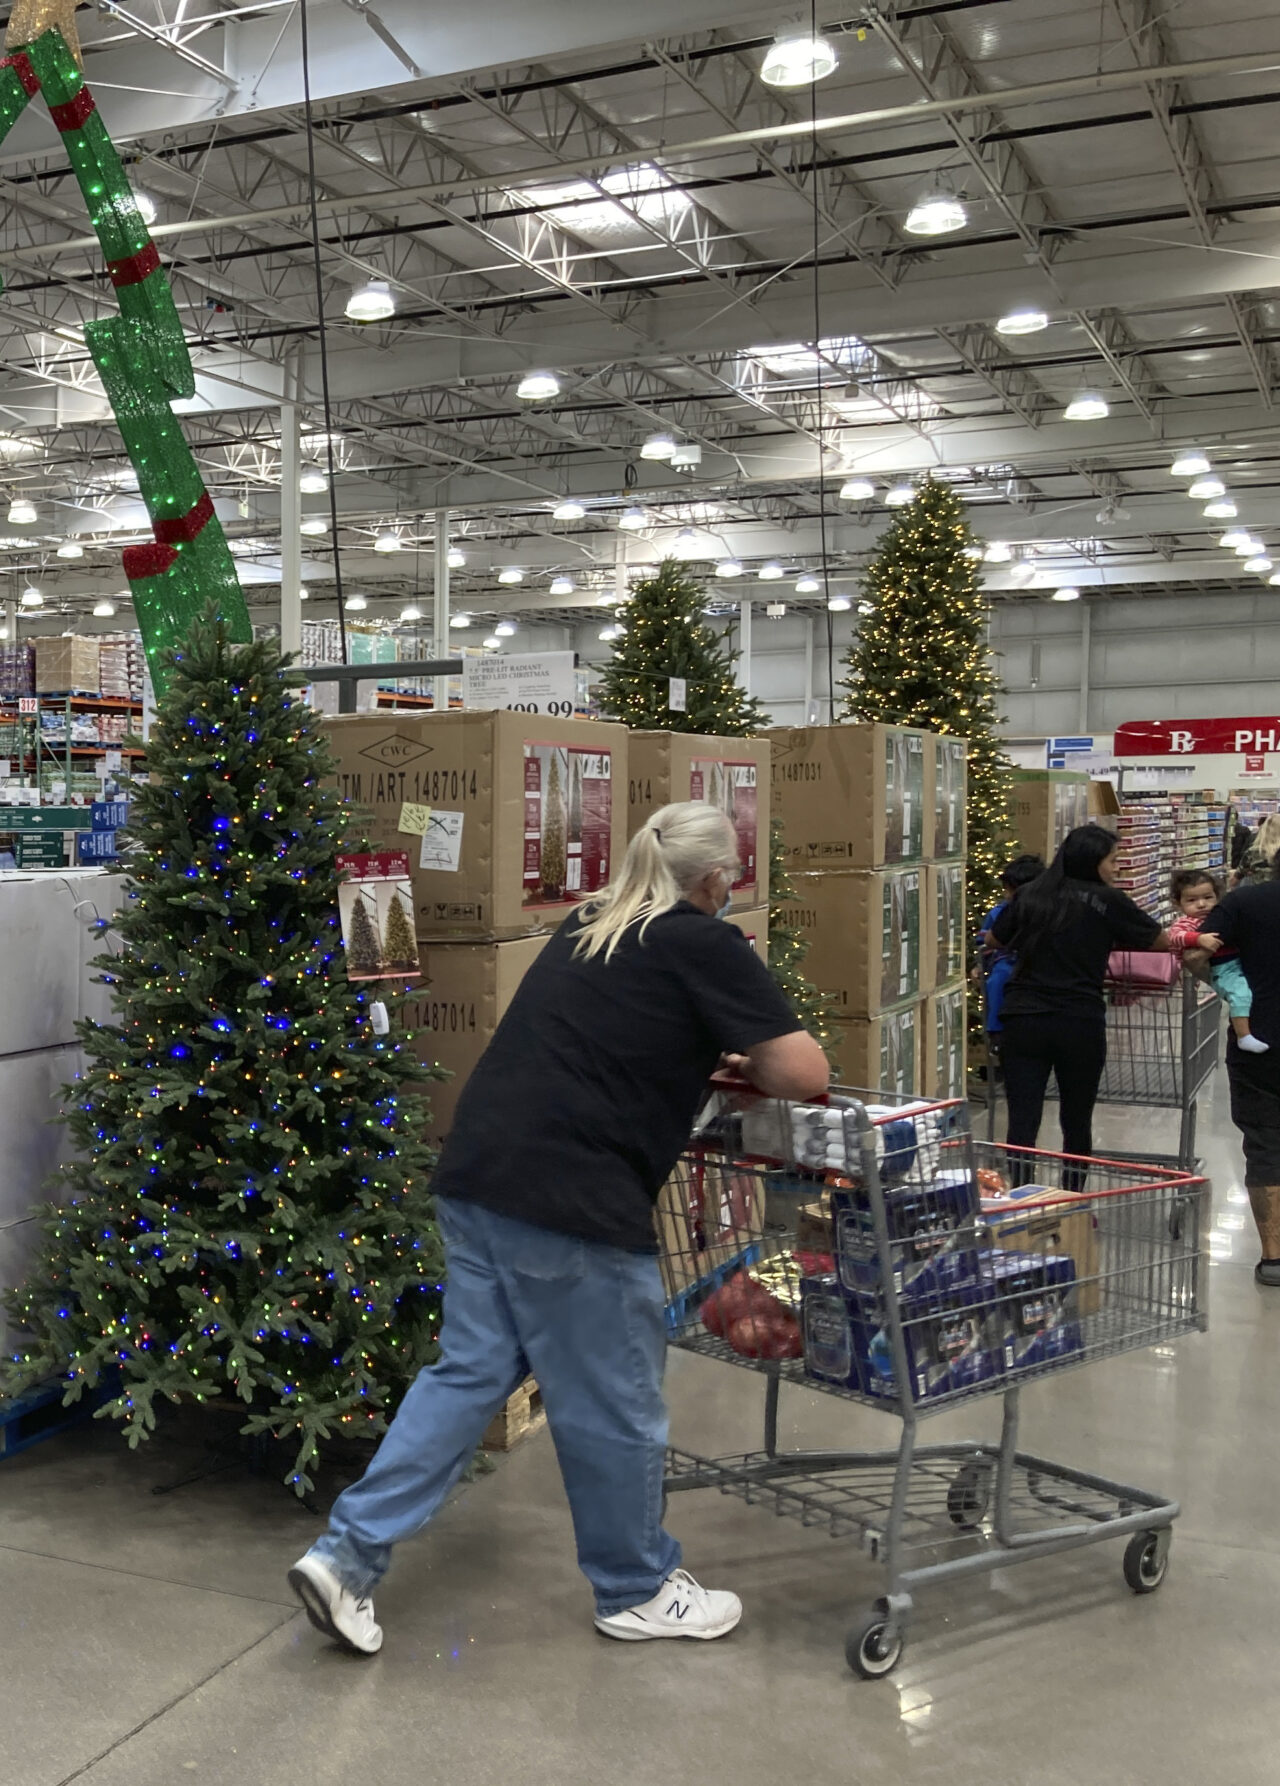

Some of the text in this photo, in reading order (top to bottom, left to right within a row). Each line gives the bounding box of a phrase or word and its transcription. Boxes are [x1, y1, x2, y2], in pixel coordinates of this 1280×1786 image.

[510, 663, 543, 672] RADIANT
[509, 670, 550, 679] CHRISTMAS
[20, 699, 37, 712] 312
[380, 744, 413, 757] CWC
[782, 761, 822, 782] 1487031
[413, 769, 477, 802] 1487014
[666, 1600, 690, 1620] N
